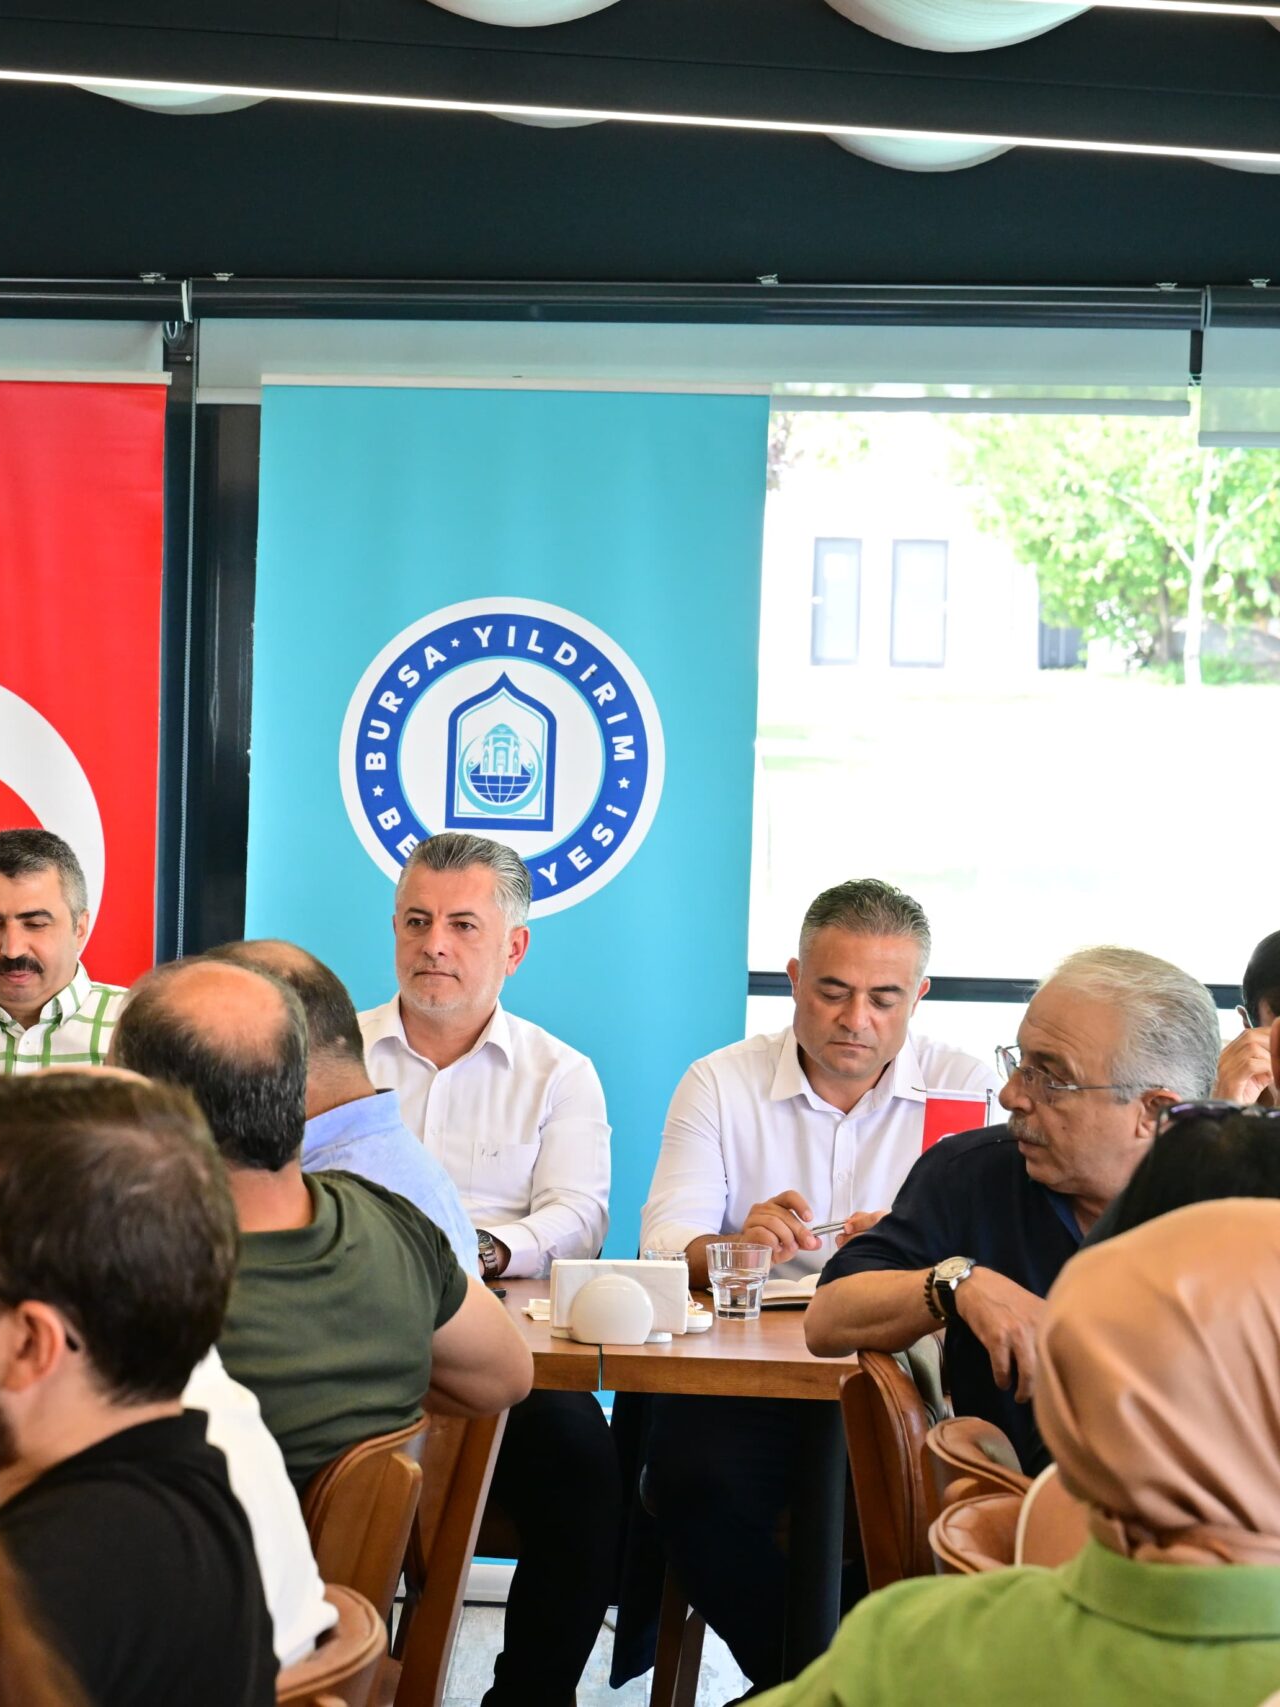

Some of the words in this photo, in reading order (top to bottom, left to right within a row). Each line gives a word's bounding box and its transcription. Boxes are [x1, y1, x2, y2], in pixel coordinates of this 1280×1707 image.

[365, 645, 447, 770] BURSA
[472, 625, 635, 761] YILDIRIM
[376, 804, 627, 887] BEYESİ
